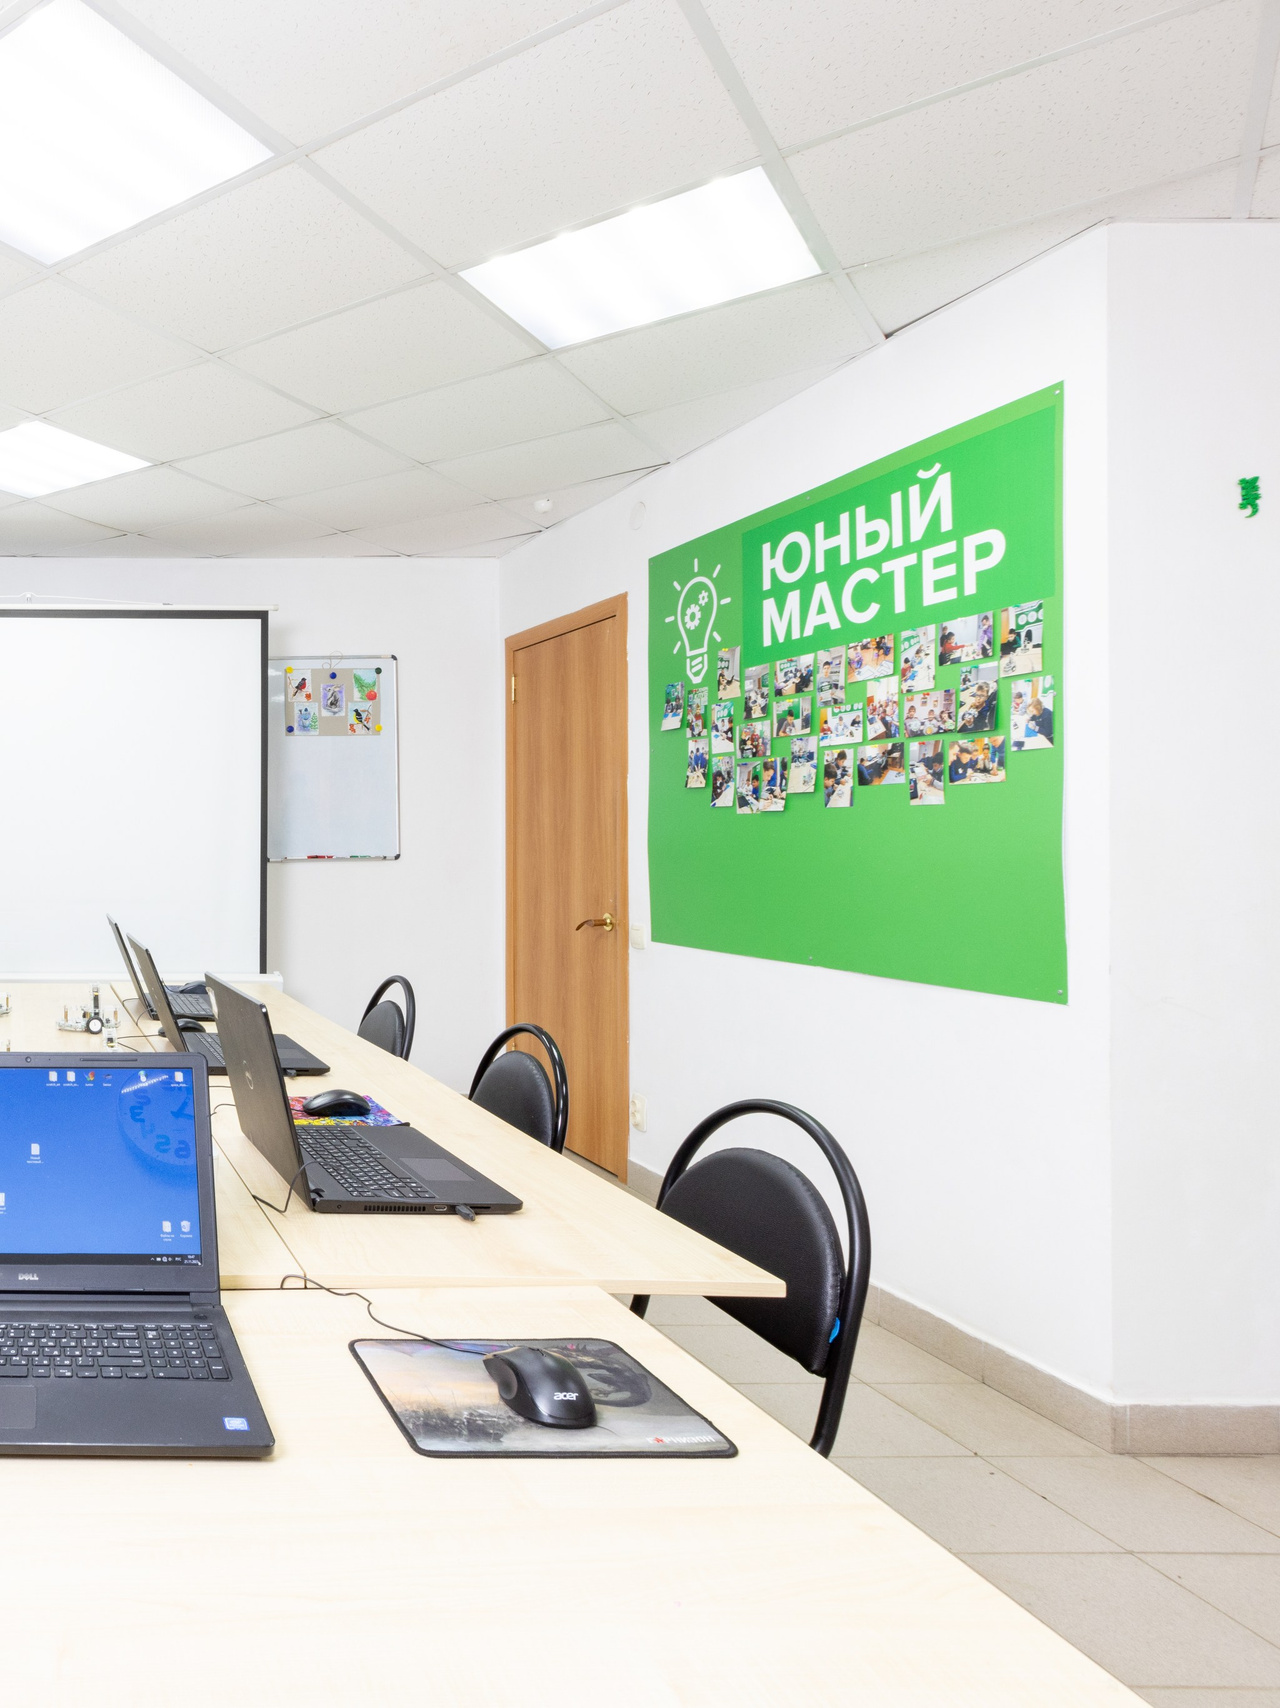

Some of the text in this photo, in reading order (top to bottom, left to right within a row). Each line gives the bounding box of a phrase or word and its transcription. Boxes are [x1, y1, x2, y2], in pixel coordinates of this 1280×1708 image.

[762, 462, 953, 591] ЮНЫЙ
[762, 529, 1006, 647] МАСТЕР
[18, 1272, 39, 1281] DELL
[553, 1391, 579, 1401] acer
